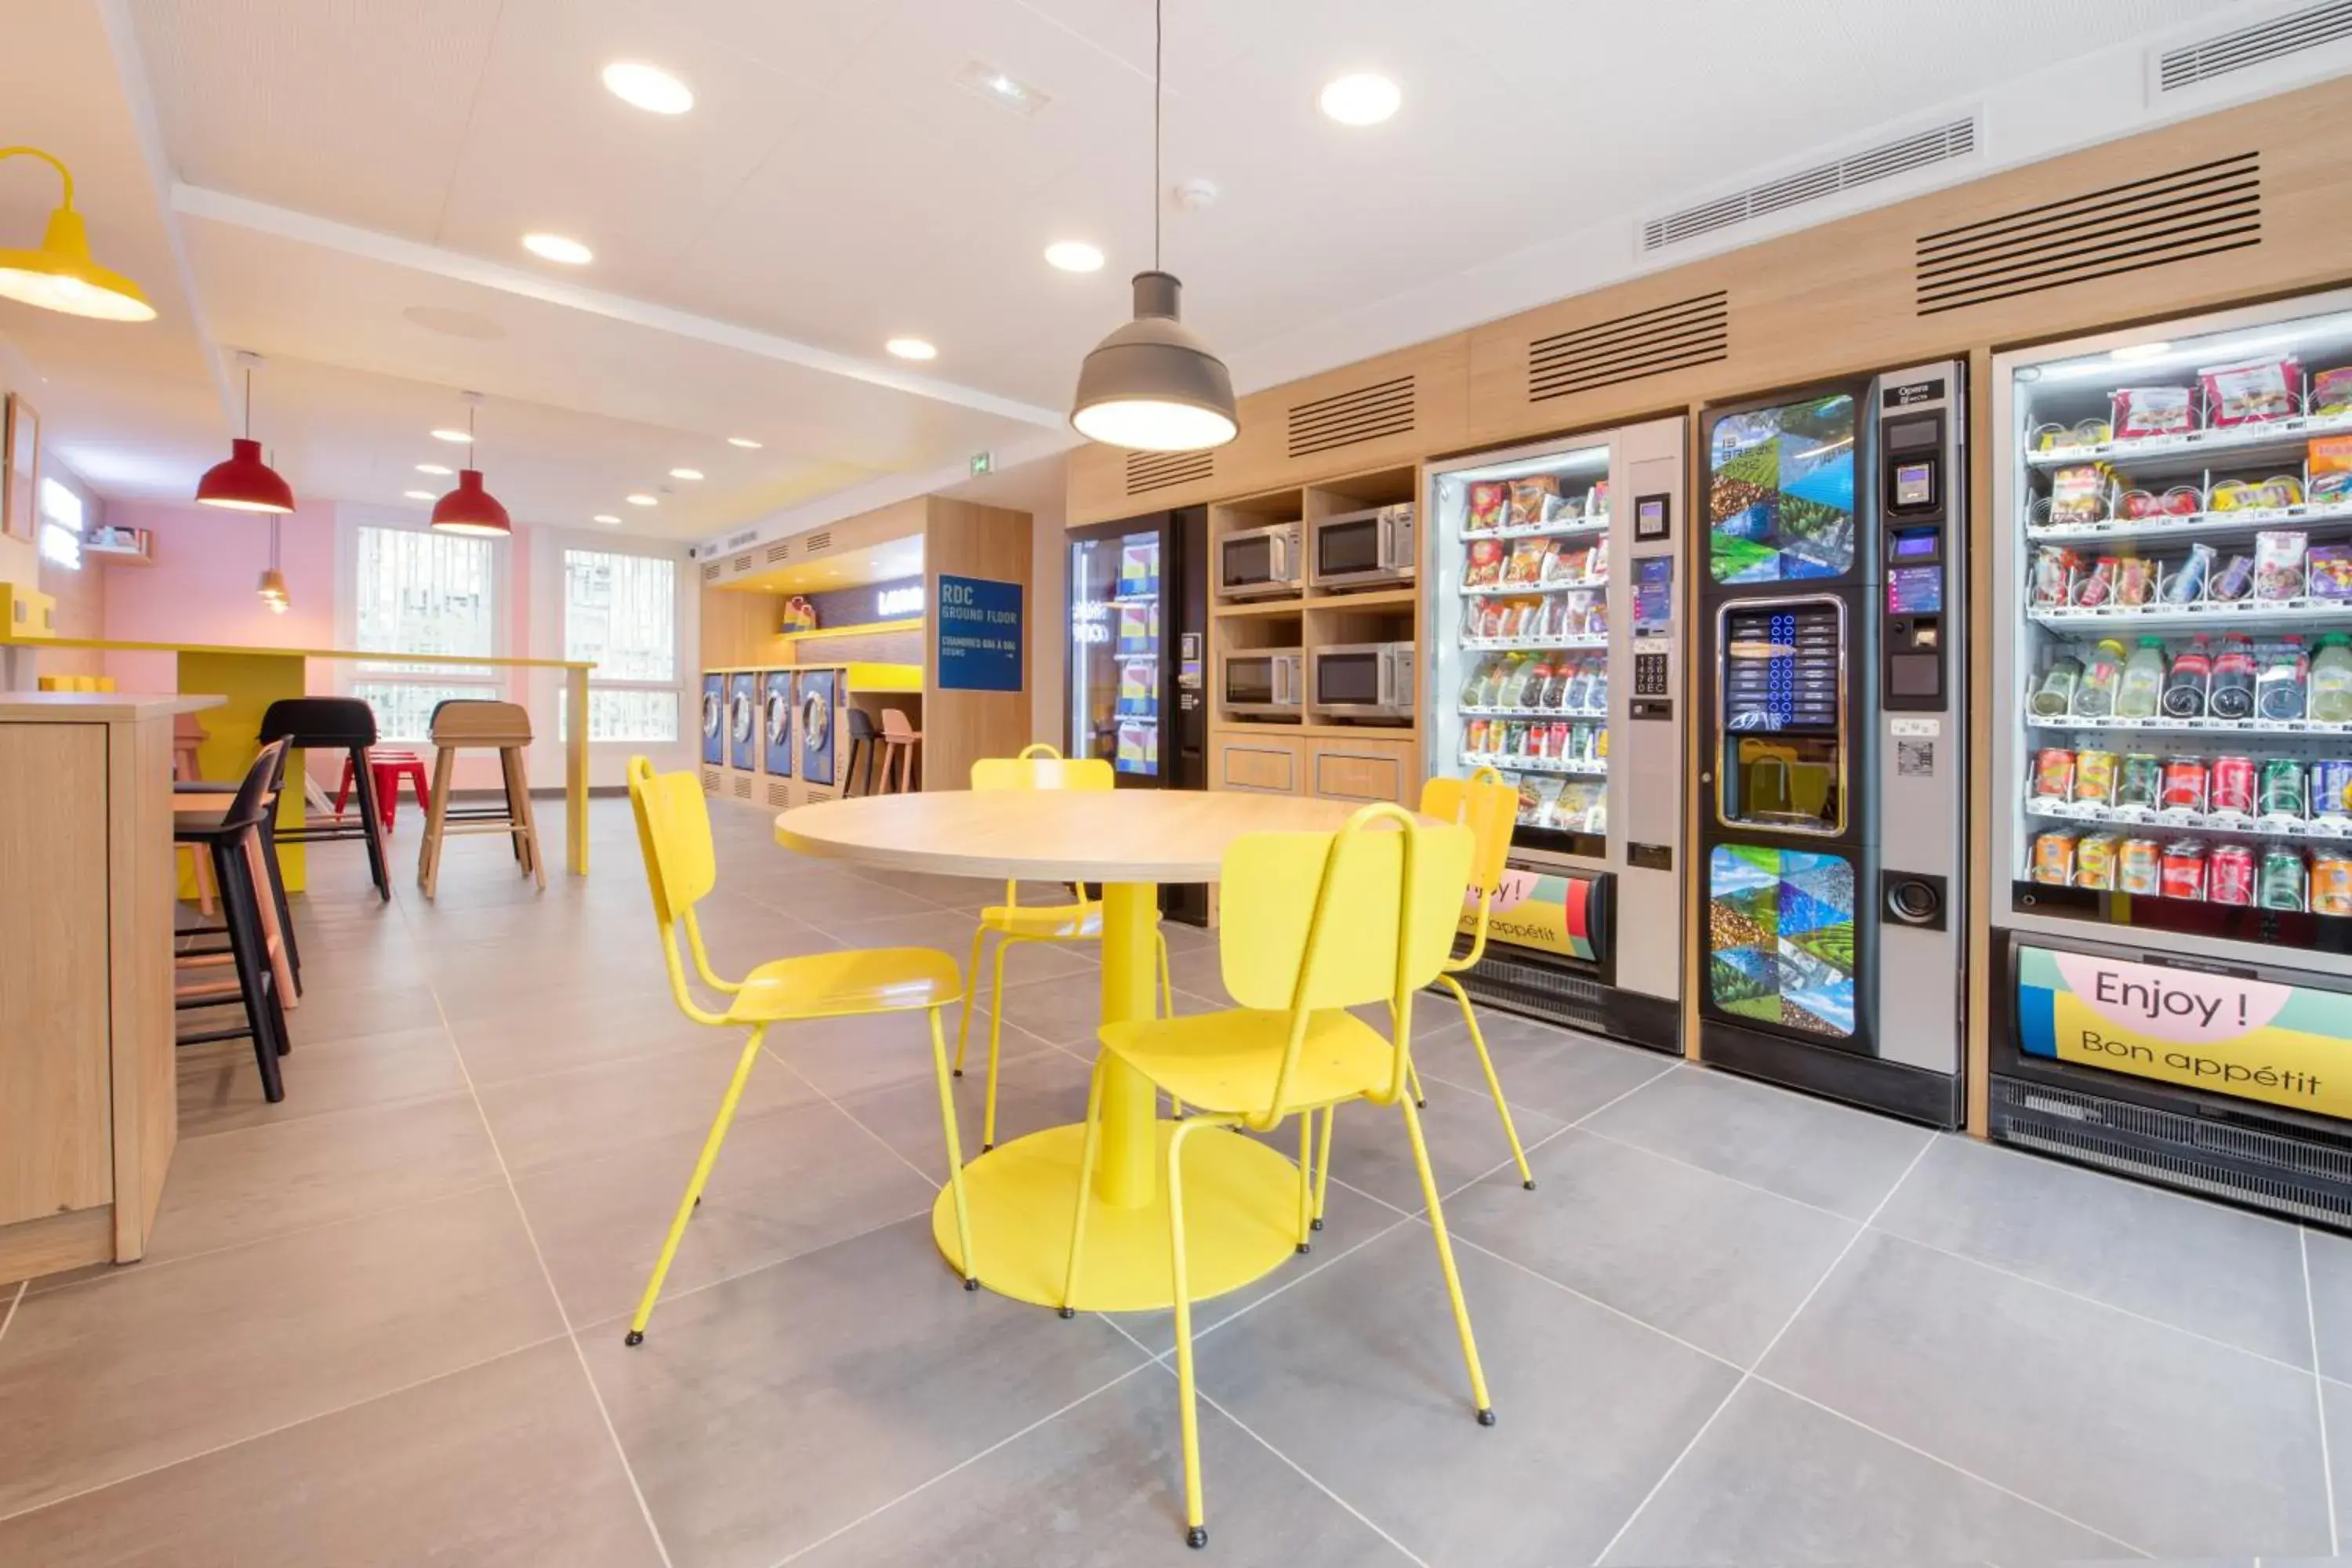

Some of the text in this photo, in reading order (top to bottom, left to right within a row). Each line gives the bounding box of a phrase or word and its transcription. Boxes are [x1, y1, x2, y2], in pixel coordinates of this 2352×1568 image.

[942, 584, 974, 605] RDC
[942, 605, 1018, 625] GROUND FLOOR
[1489, 918, 1556, 942] appétit
[2095, 971, 2222, 1029] Enjoy
[2082, 1029, 2322, 1096] Bon appétit
